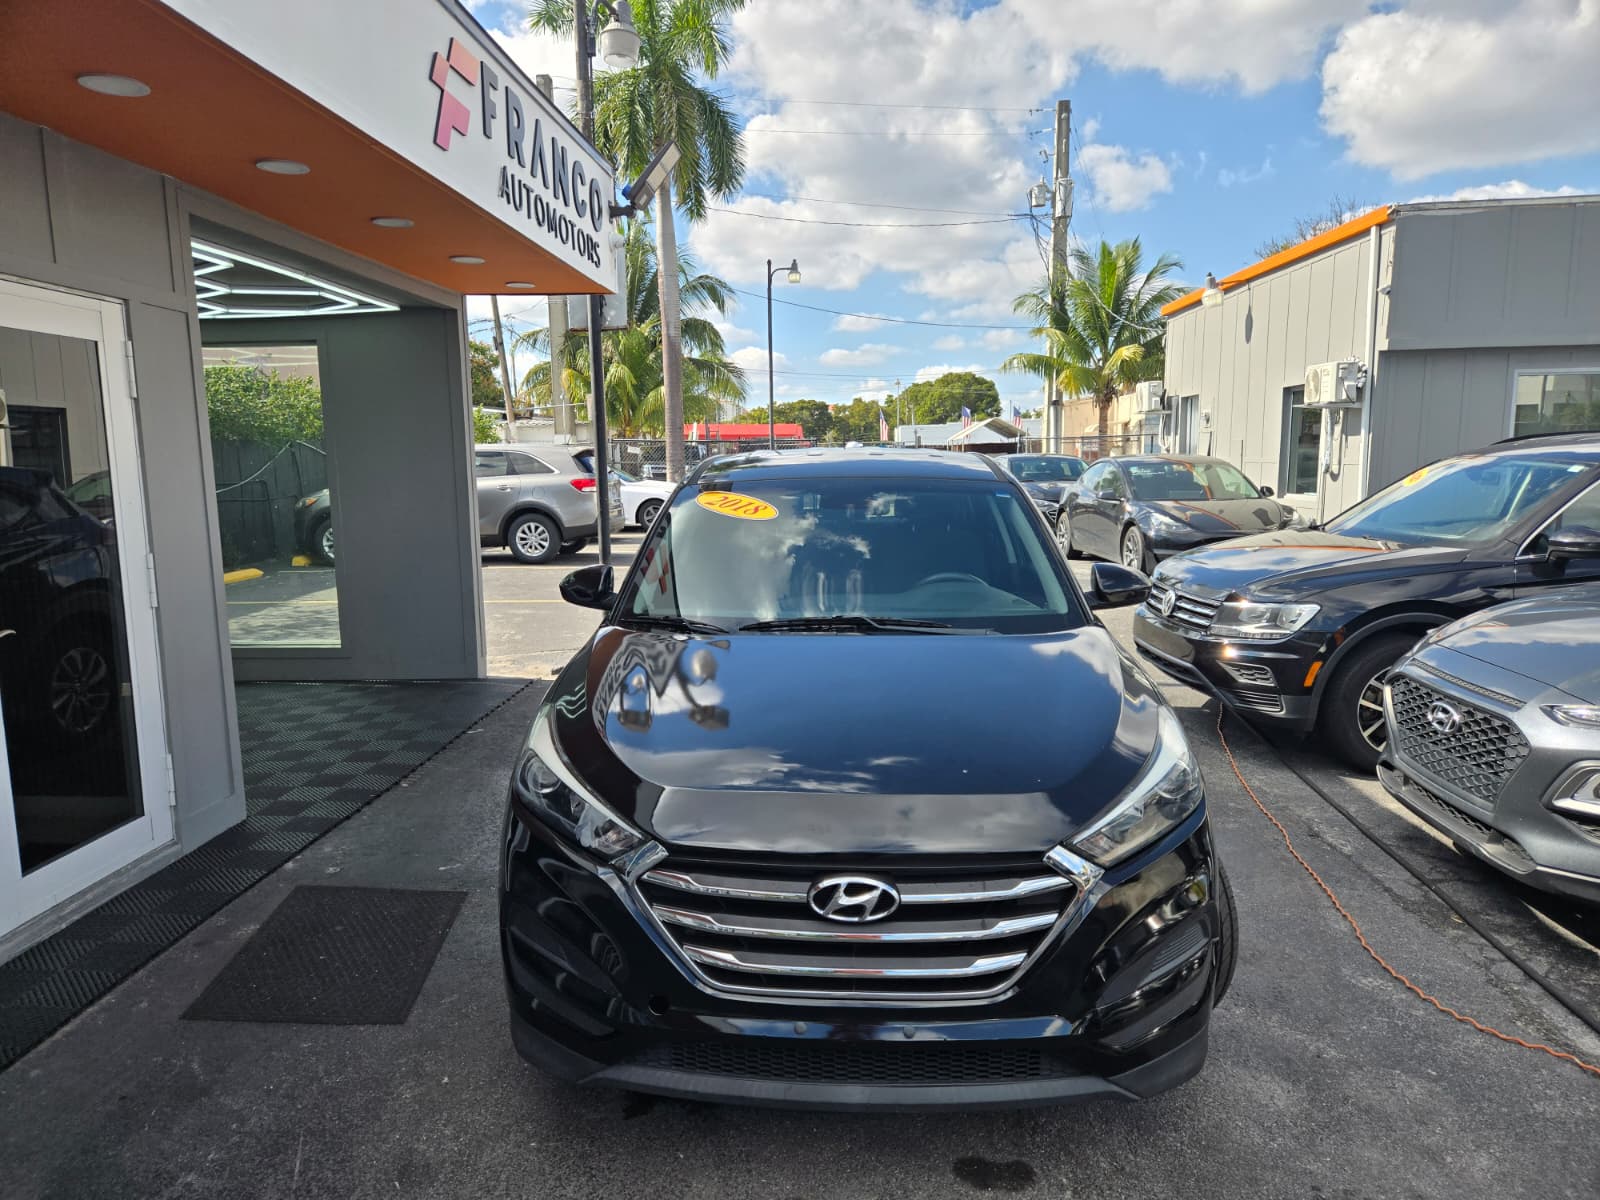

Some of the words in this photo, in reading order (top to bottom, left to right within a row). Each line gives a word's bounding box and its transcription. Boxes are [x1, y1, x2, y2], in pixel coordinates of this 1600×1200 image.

[480, 60, 604, 233] FRANCO
[499, 165, 602, 269] AUTOMOTORS
[704, 495, 767, 516] 2018
